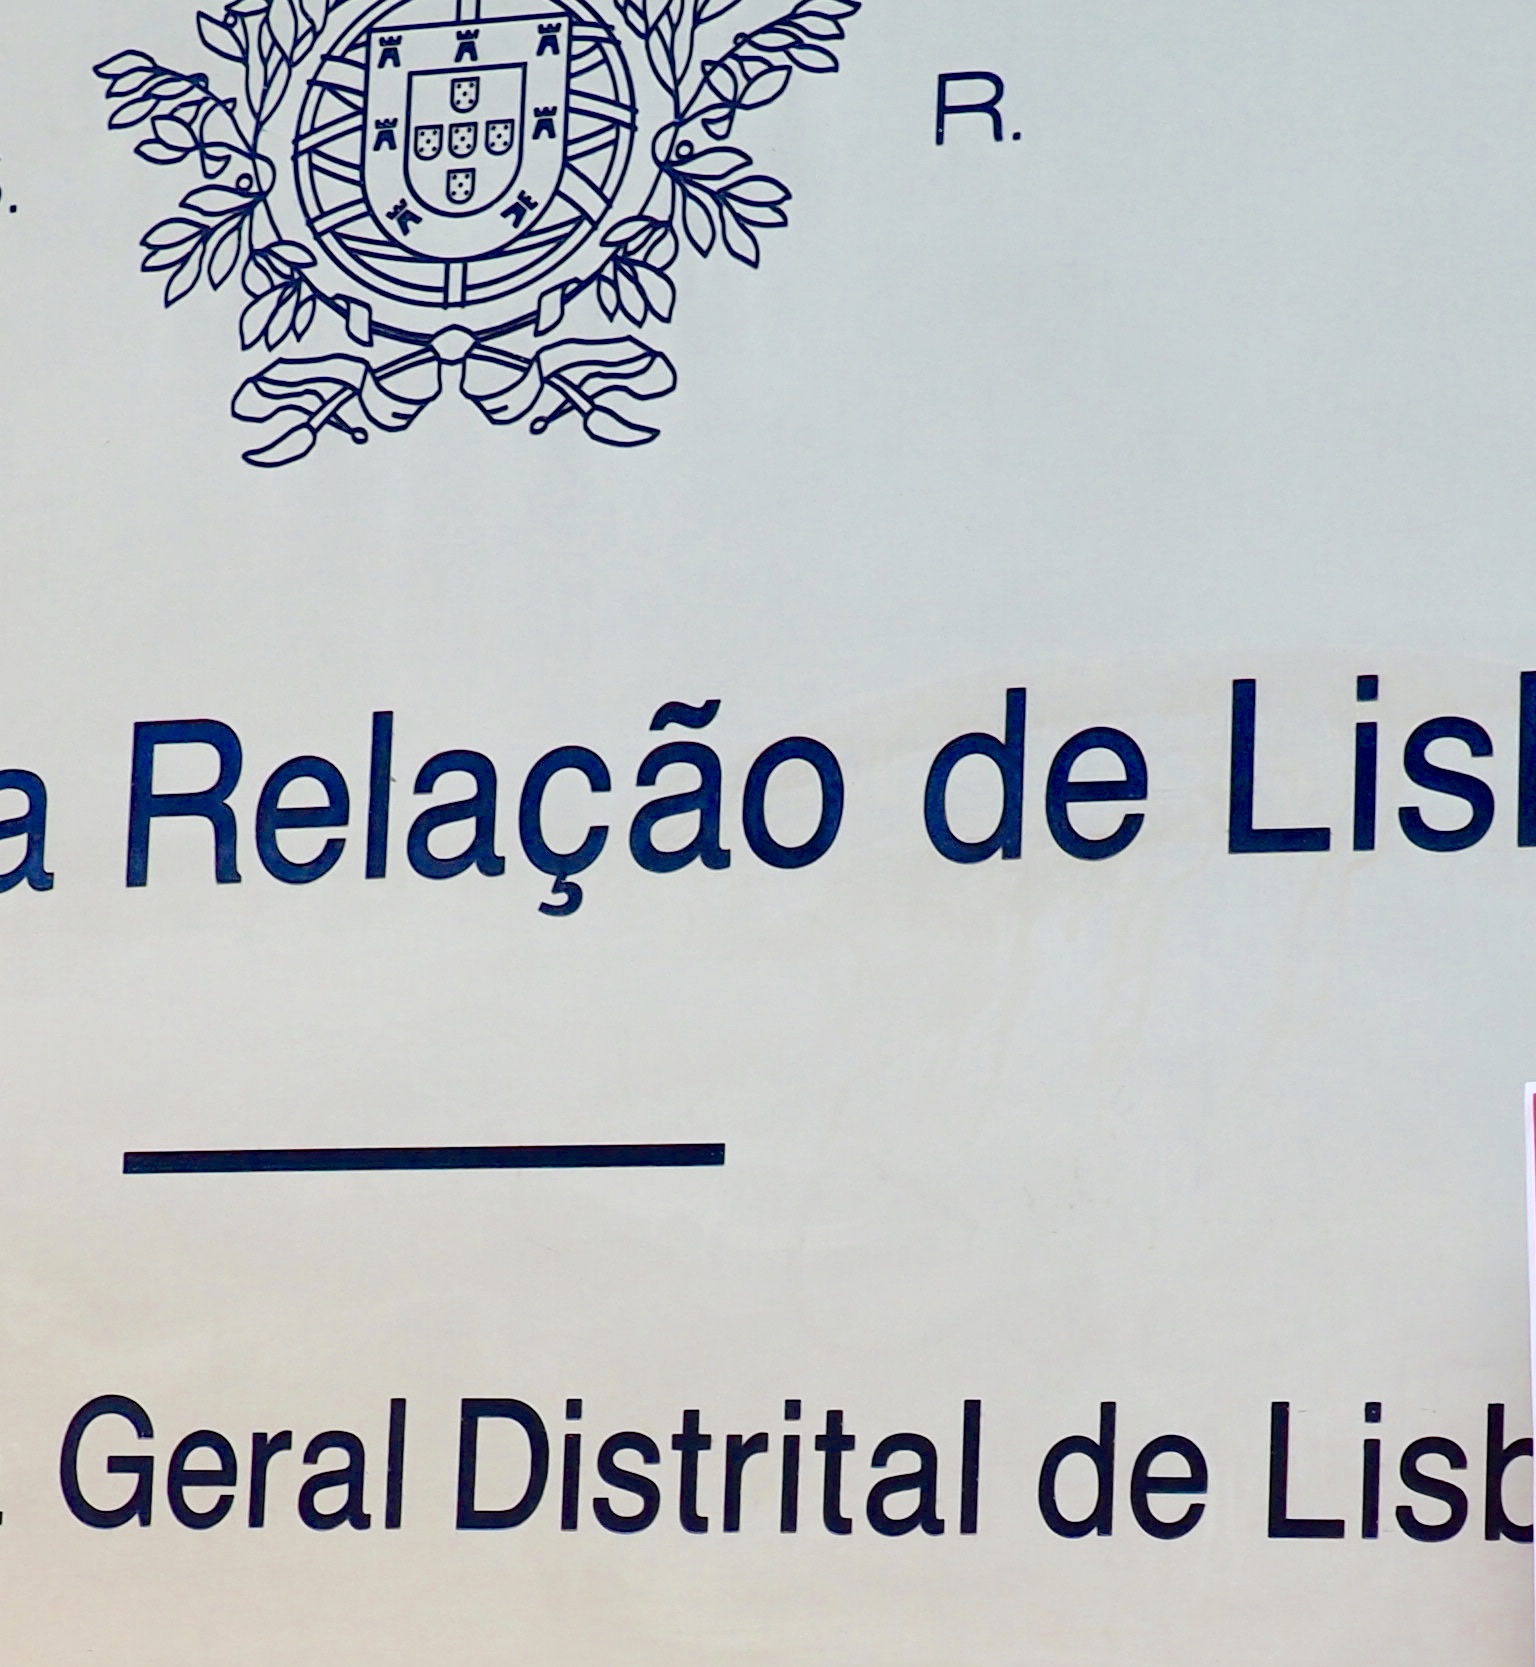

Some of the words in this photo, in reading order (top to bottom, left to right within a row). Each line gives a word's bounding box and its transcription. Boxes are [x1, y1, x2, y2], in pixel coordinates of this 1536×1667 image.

[935, 70, 1022, 146] R.
[126, 699, 846, 917] Relação
[923, 687, 1149, 865] de
[59, 1394, 406, 1531] Geral
[455, 1397, 981, 1535] Distrital
[1038, 1401, 1208, 1540] de
[1267, 1400, 1536, 1543] Lisb
